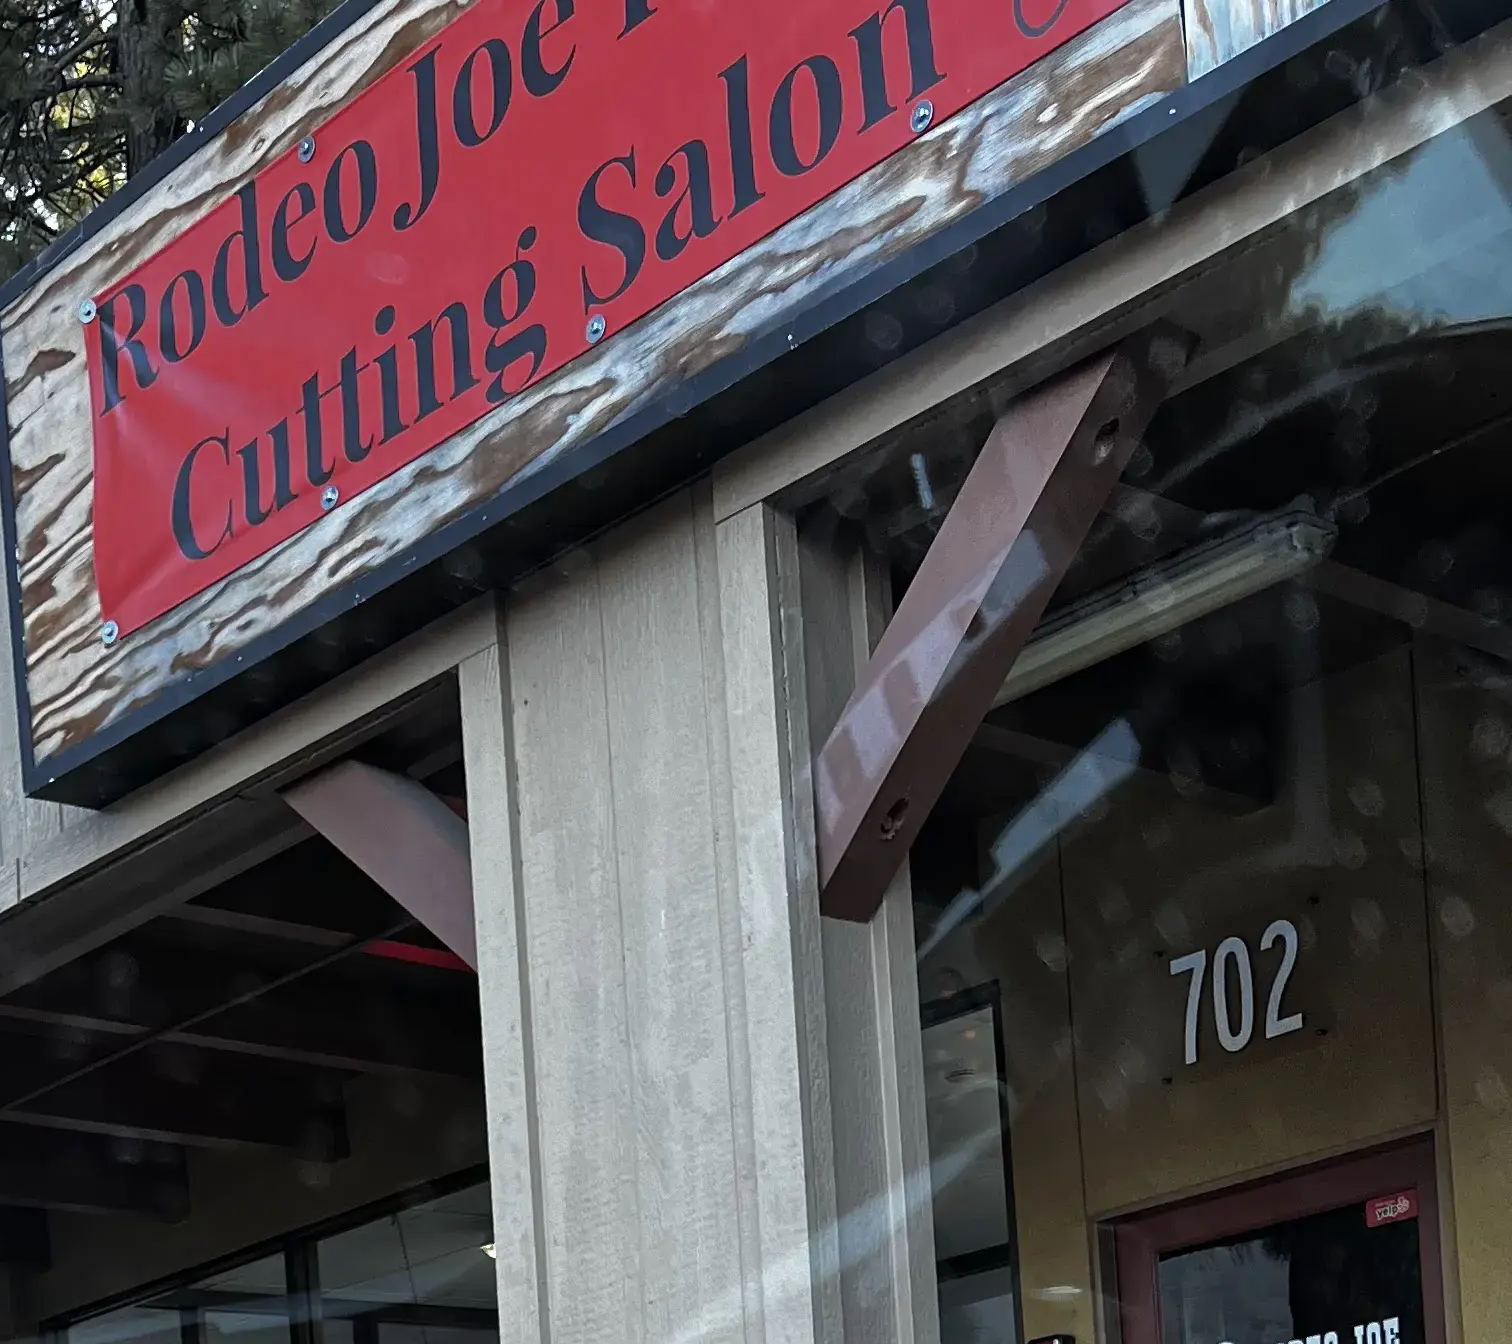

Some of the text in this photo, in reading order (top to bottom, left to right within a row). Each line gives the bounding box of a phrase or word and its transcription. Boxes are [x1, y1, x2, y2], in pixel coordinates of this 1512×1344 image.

[95, 0, 577, 417] Rodeo Joe
[170, 0, 947, 562] Cutting Salon
[1169, 919, 1303, 1065] 702
